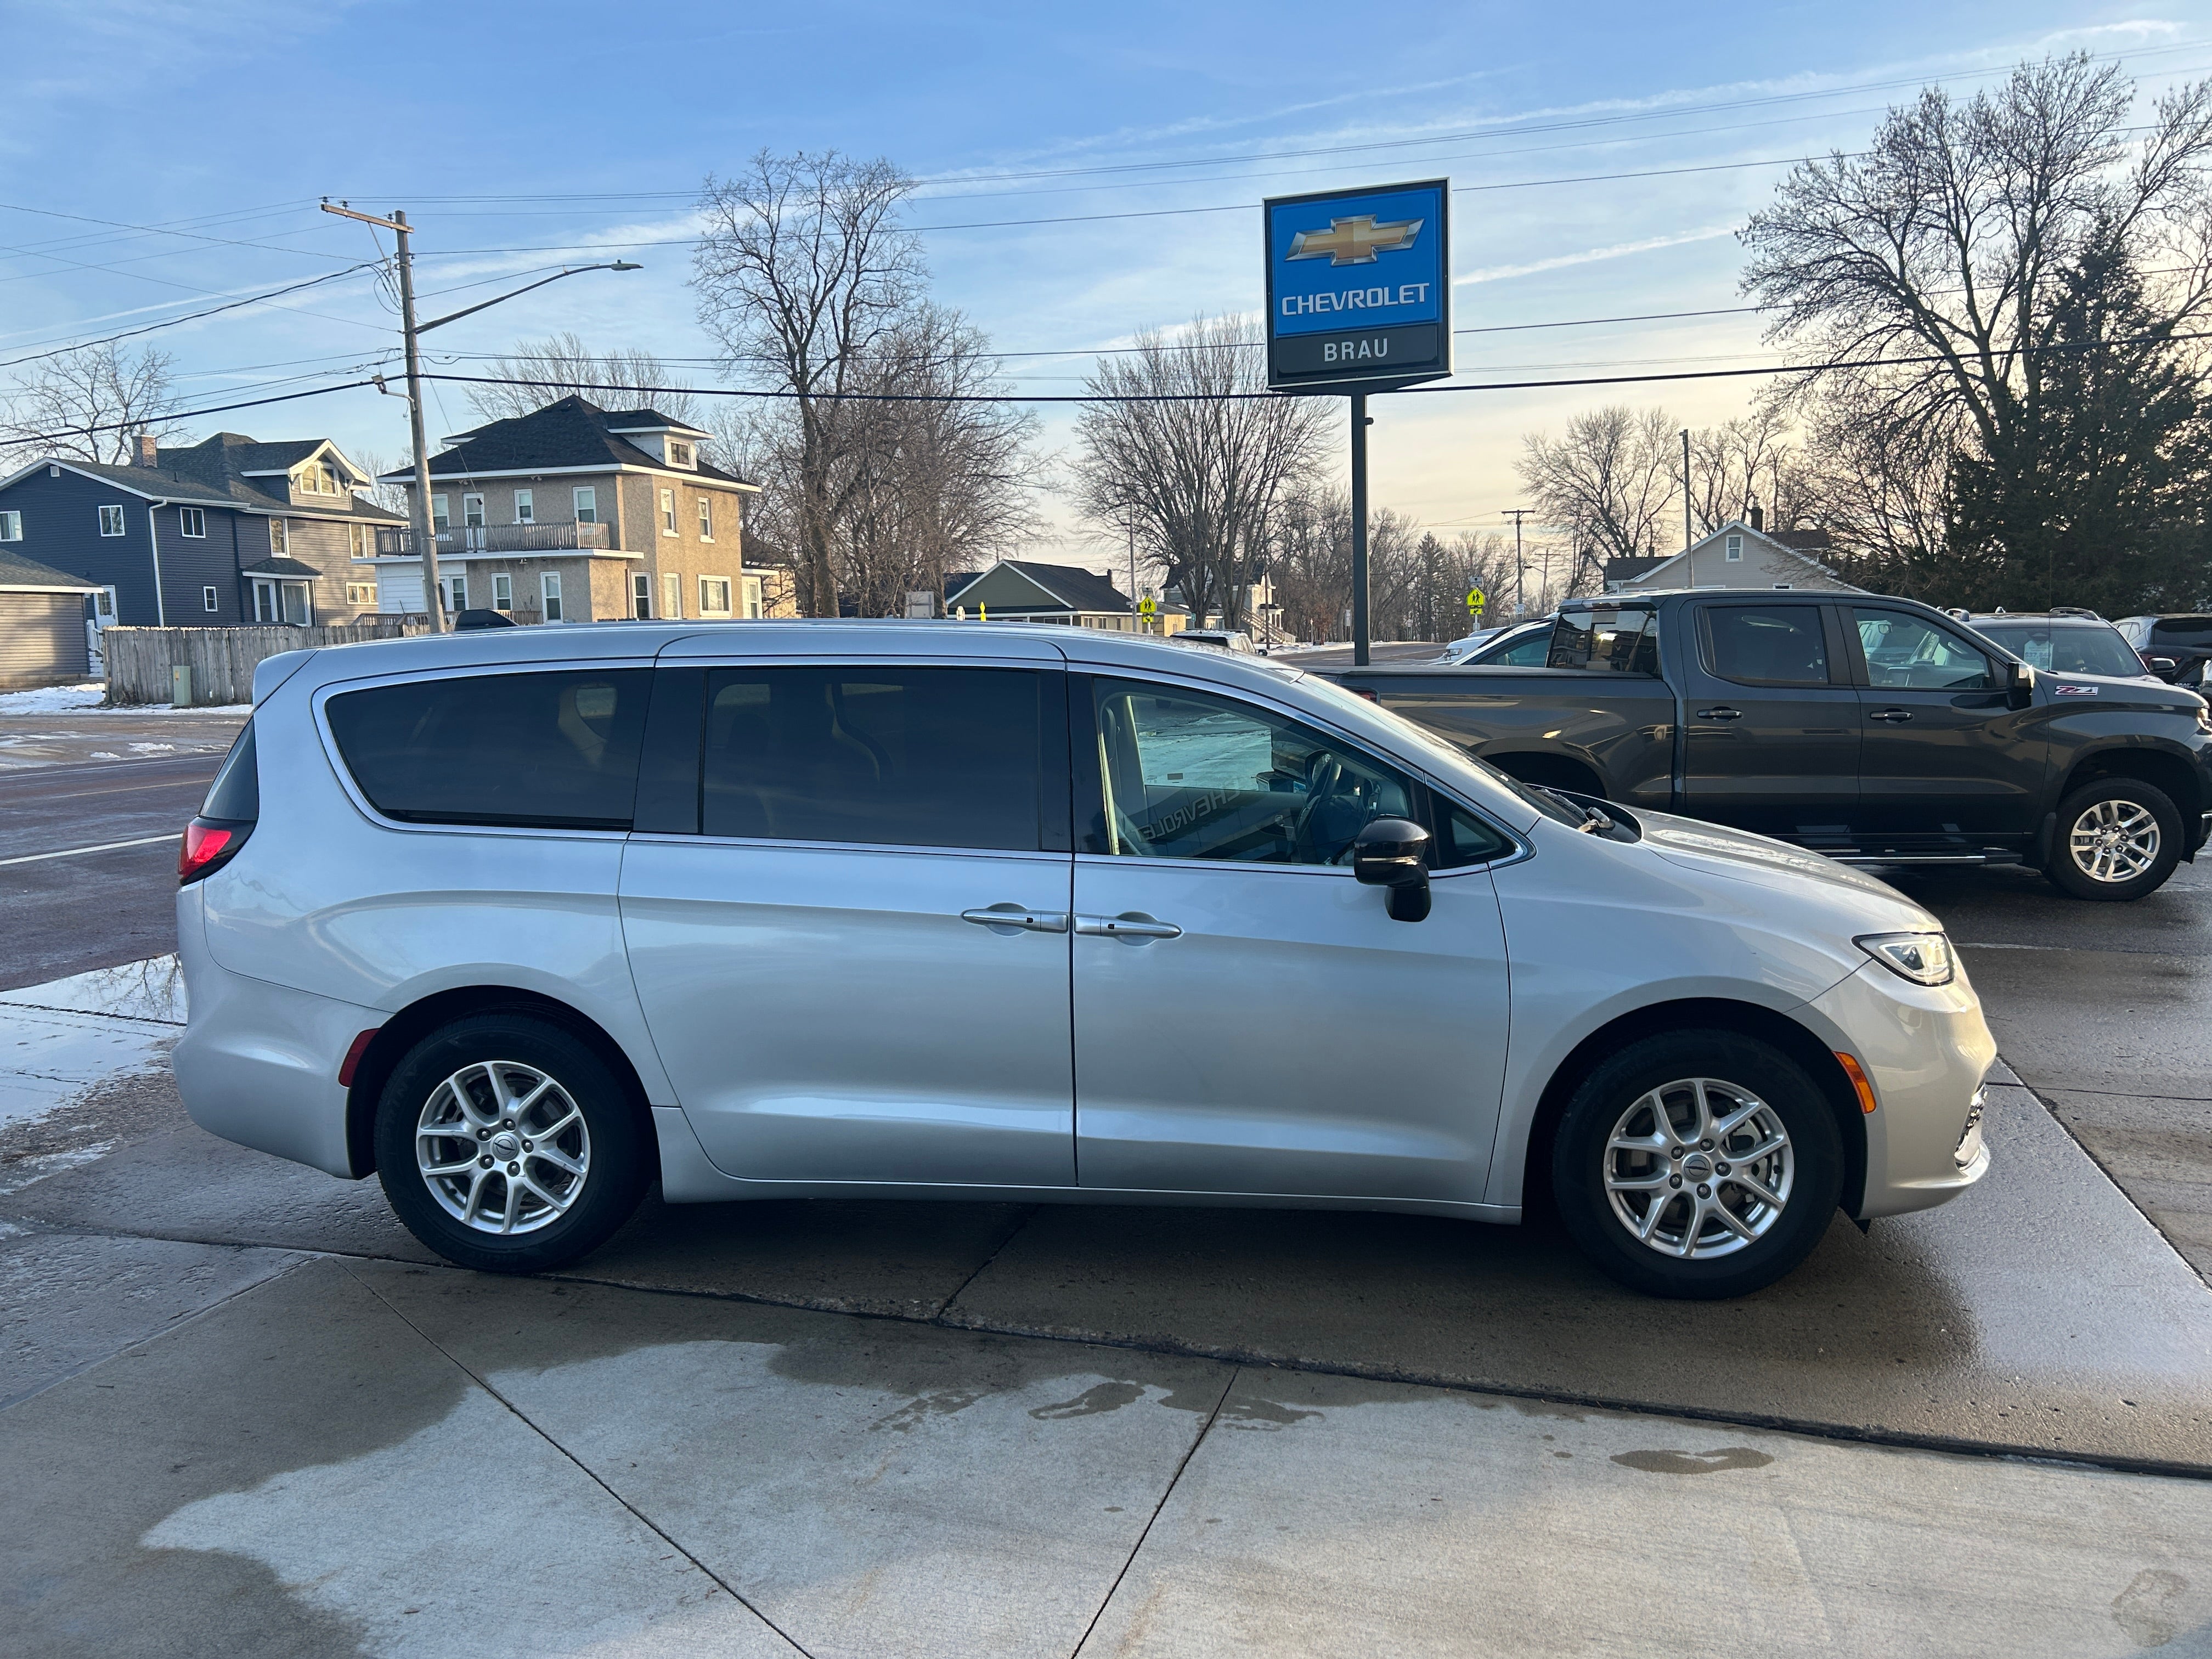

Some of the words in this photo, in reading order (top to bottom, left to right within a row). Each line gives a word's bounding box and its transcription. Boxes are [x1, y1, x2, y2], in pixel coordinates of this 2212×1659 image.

[1282, 283, 1430, 316] CHEVROLET
[1324, 338, 1388, 362] BRAU
[2055, 685, 2098, 696] Z71
